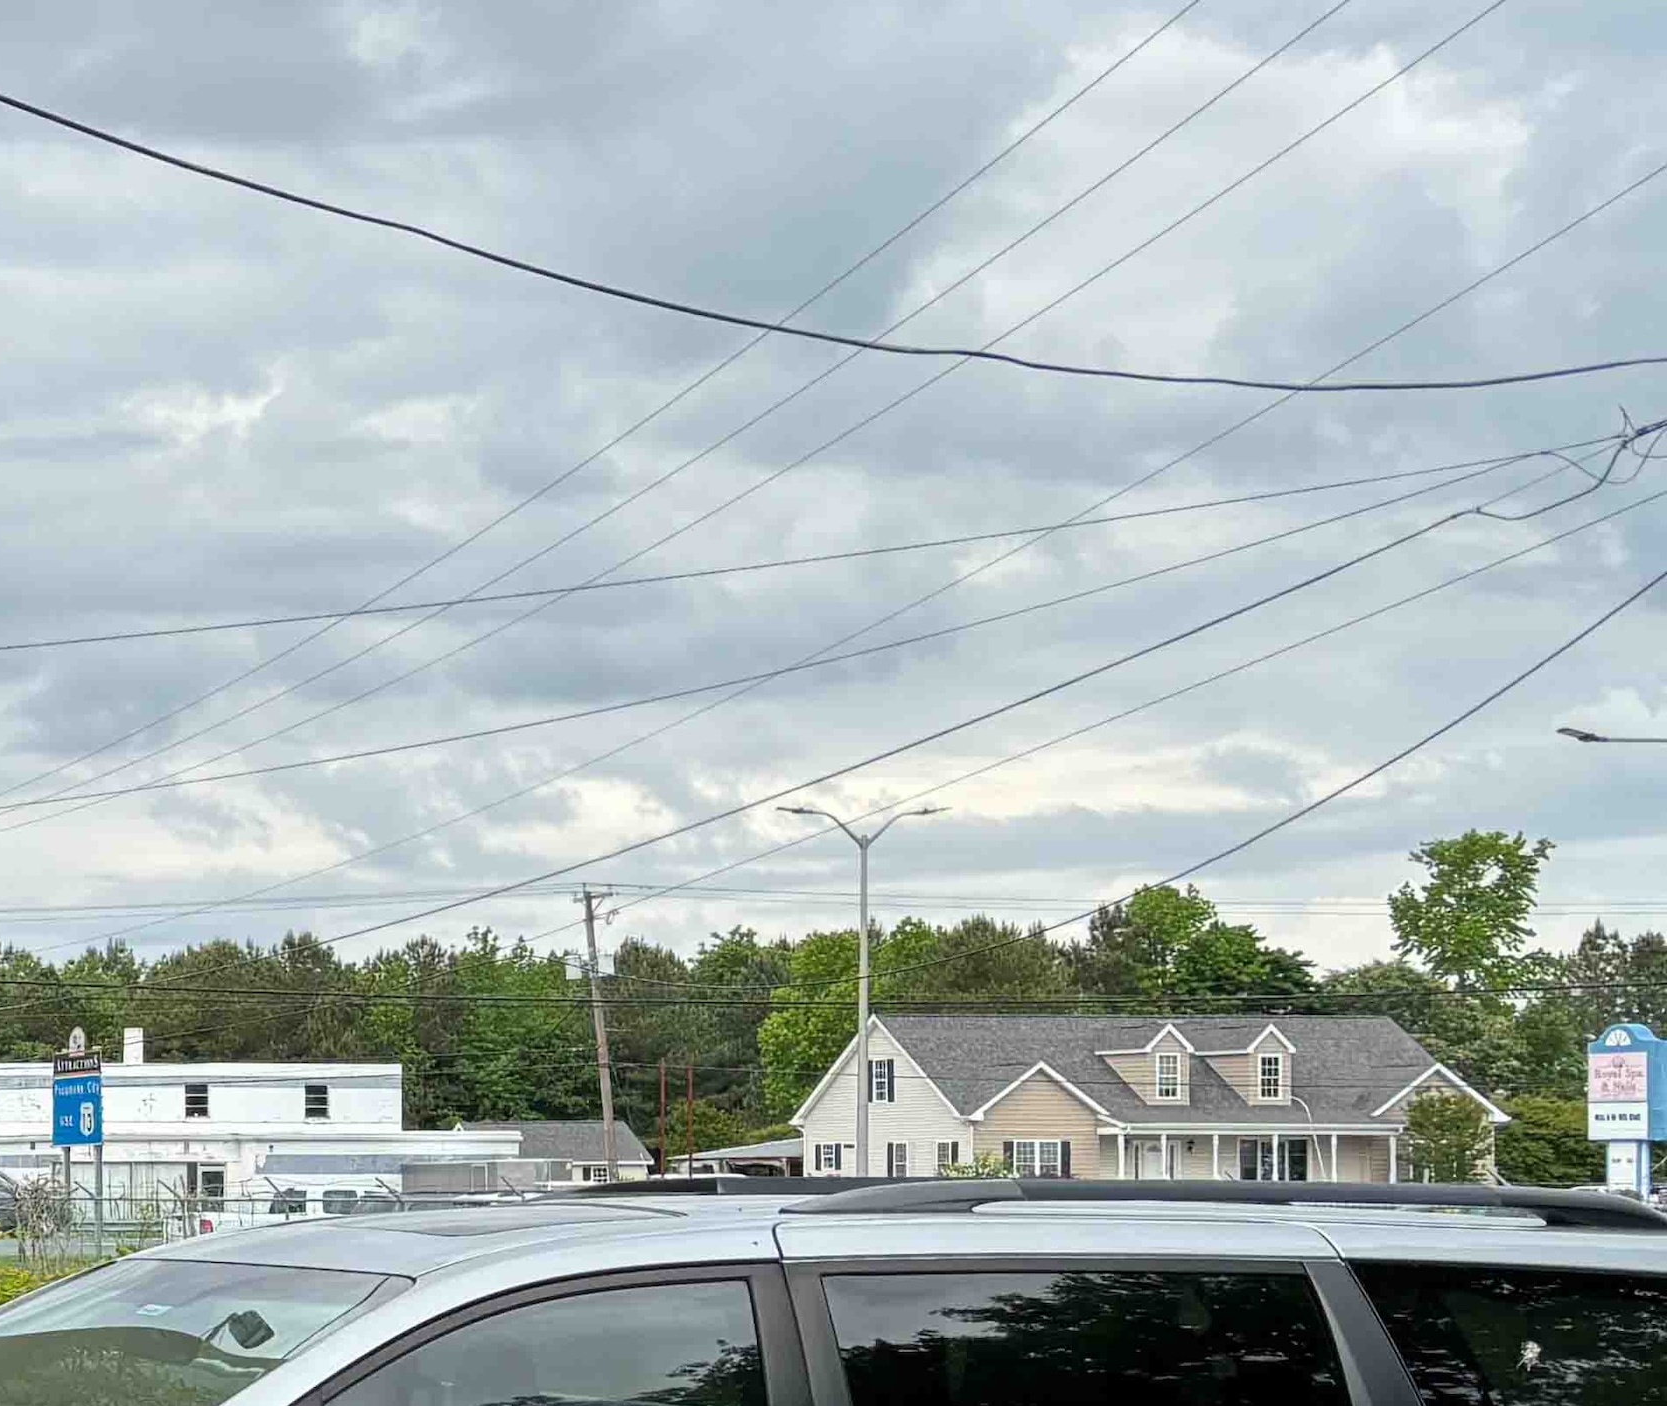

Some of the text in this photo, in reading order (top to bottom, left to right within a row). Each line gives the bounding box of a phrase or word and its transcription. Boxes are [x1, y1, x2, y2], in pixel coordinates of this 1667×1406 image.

[57, 1056, 98, 1071] ATTRACTIONS
[1594, 1066, 1644, 1081] Royal Spa
